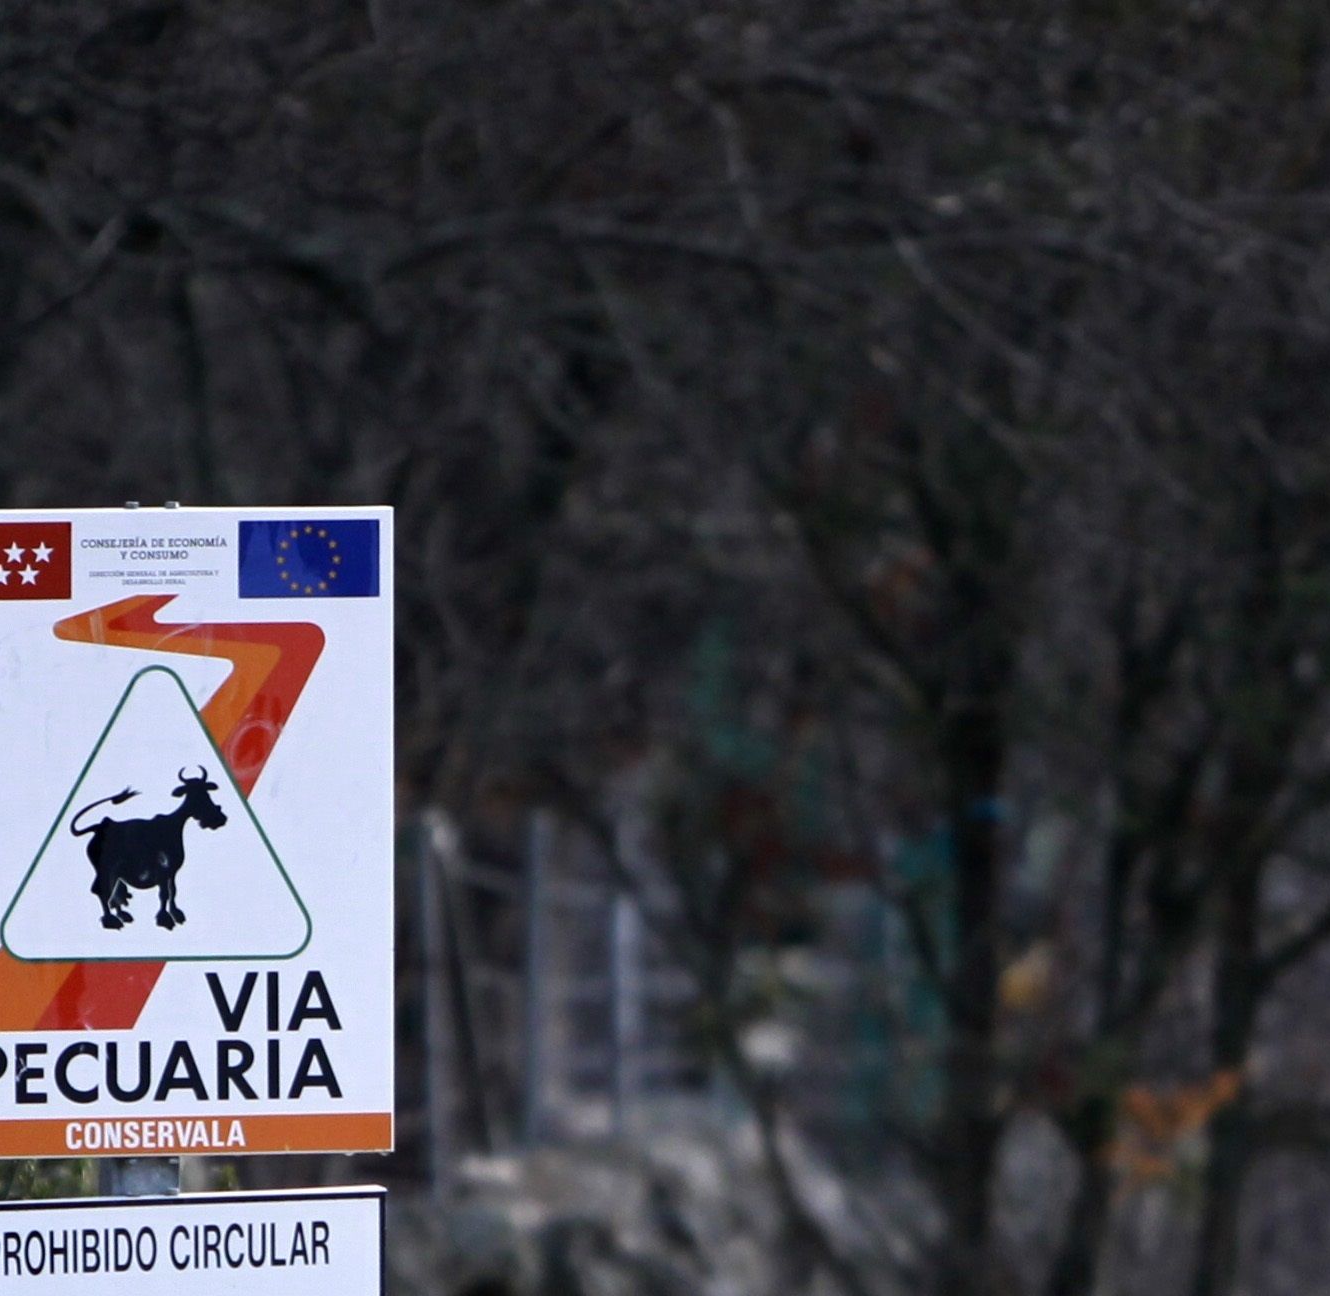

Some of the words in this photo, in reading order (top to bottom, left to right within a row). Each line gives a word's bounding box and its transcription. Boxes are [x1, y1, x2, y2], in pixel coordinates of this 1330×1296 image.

[81, 537, 147, 548] CONSEJERÍA
[151, 538, 164, 548] DE
[168, 536, 227, 547] ECONOMÍA
[120, 551, 127, 560] Y
[130, 550, 188, 560] CONSUMO
[205, 971, 342, 1032] VIA
[65, 1120, 246, 1149] CONSERVALA
[170, 1221, 329, 1270] CIRCULAR
